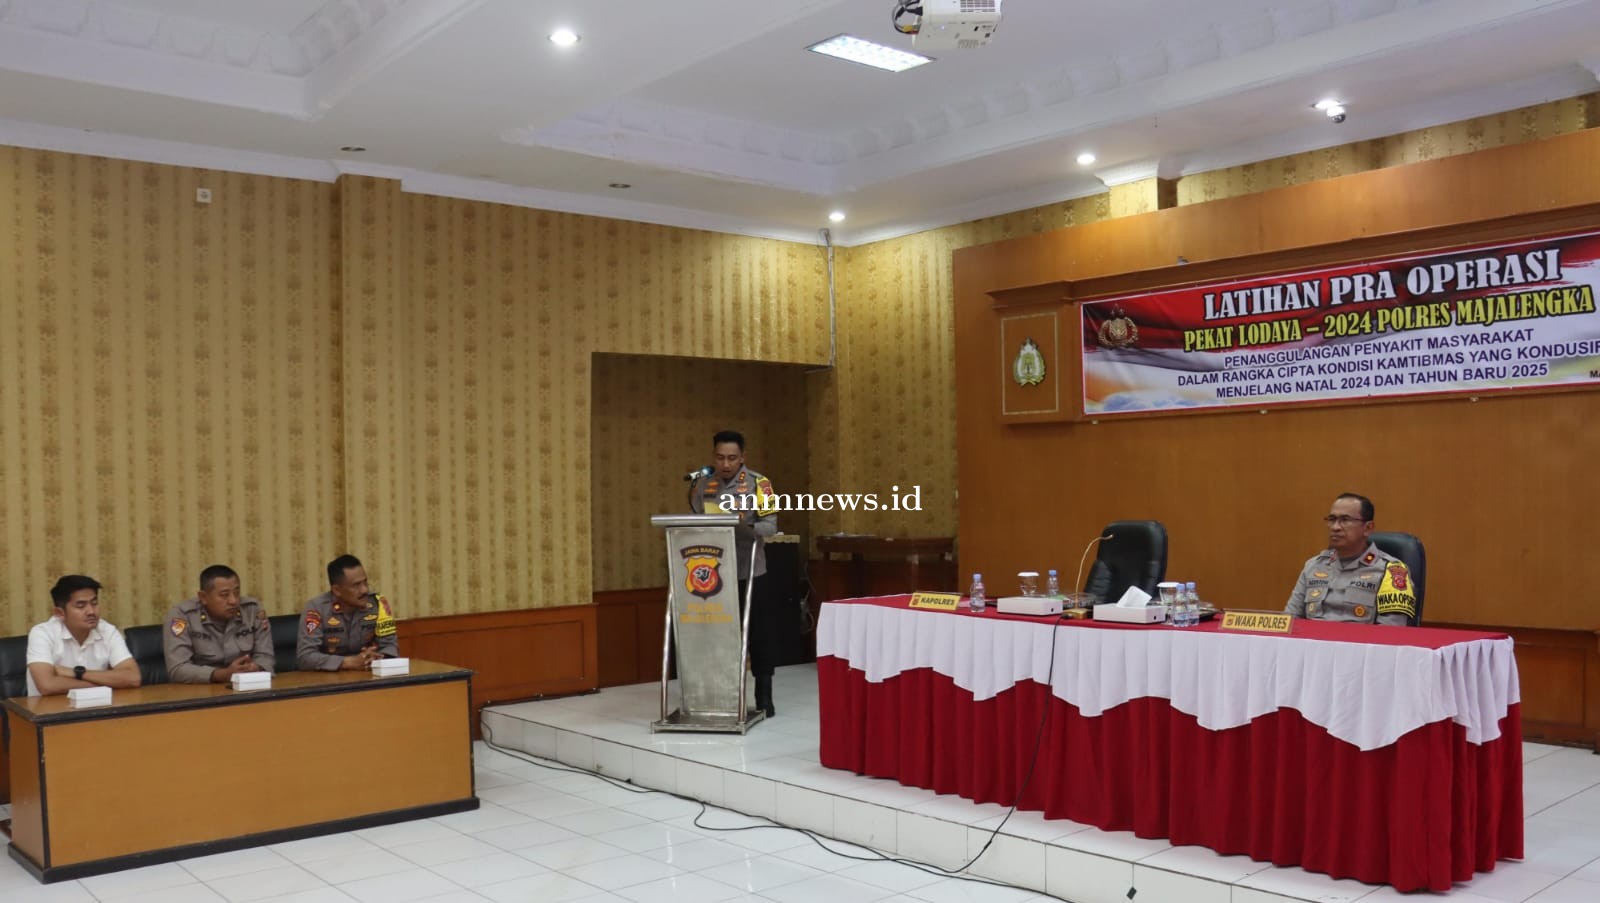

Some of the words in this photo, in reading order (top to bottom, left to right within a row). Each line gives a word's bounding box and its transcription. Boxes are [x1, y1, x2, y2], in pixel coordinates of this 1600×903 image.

[1204, 279, 1321, 320] LATIHAN
[1330, 271, 1396, 305] PRA
[1406, 249, 1561, 296] OPERASI
[1184, 326, 1234, 352] PEKAT
[1239, 319, 1302, 346] LODAYA
[1324, 312, 1372, 337] 2024
[1377, 302, 1450, 331] POLRES
[1456, 287, 1595, 326] MAJALENGKA
[1224, 345, 1350, 367] PENANGGULANGAN
[1354, 338, 1423, 355] PENYAKIT
[1427, 328, 1534, 349] MASYARAKAT
[1178, 373, 1219, 386] DALAM
[1222, 369, 1274, 383] RANGKA
[1278, 365, 1315, 378] CIPTA
[1319, 359, 1373, 375] KONDISI
[1377, 352, 1465, 370] KAMTIBMAS
[1470, 348, 1512, 363] YANG
[1216, 383, 1292, 398] MENJELANG
[1296, 379, 1337, 393] NATAL
[1341, 375, 1371, 389] 2024
[1374, 372, 1404, 387] DAN
[1408, 369, 1458, 384] TAHUN
[1463, 366, 1507, 381] BARU
[1512, 363, 1548, 378] 2025
[1350, 581, 1376, 590] POLRI
[1377, 593, 1398, 605] WAKA
[1234, 615, 1257, 627] WAKA
[1257, 616, 1288, 630] POLRES
